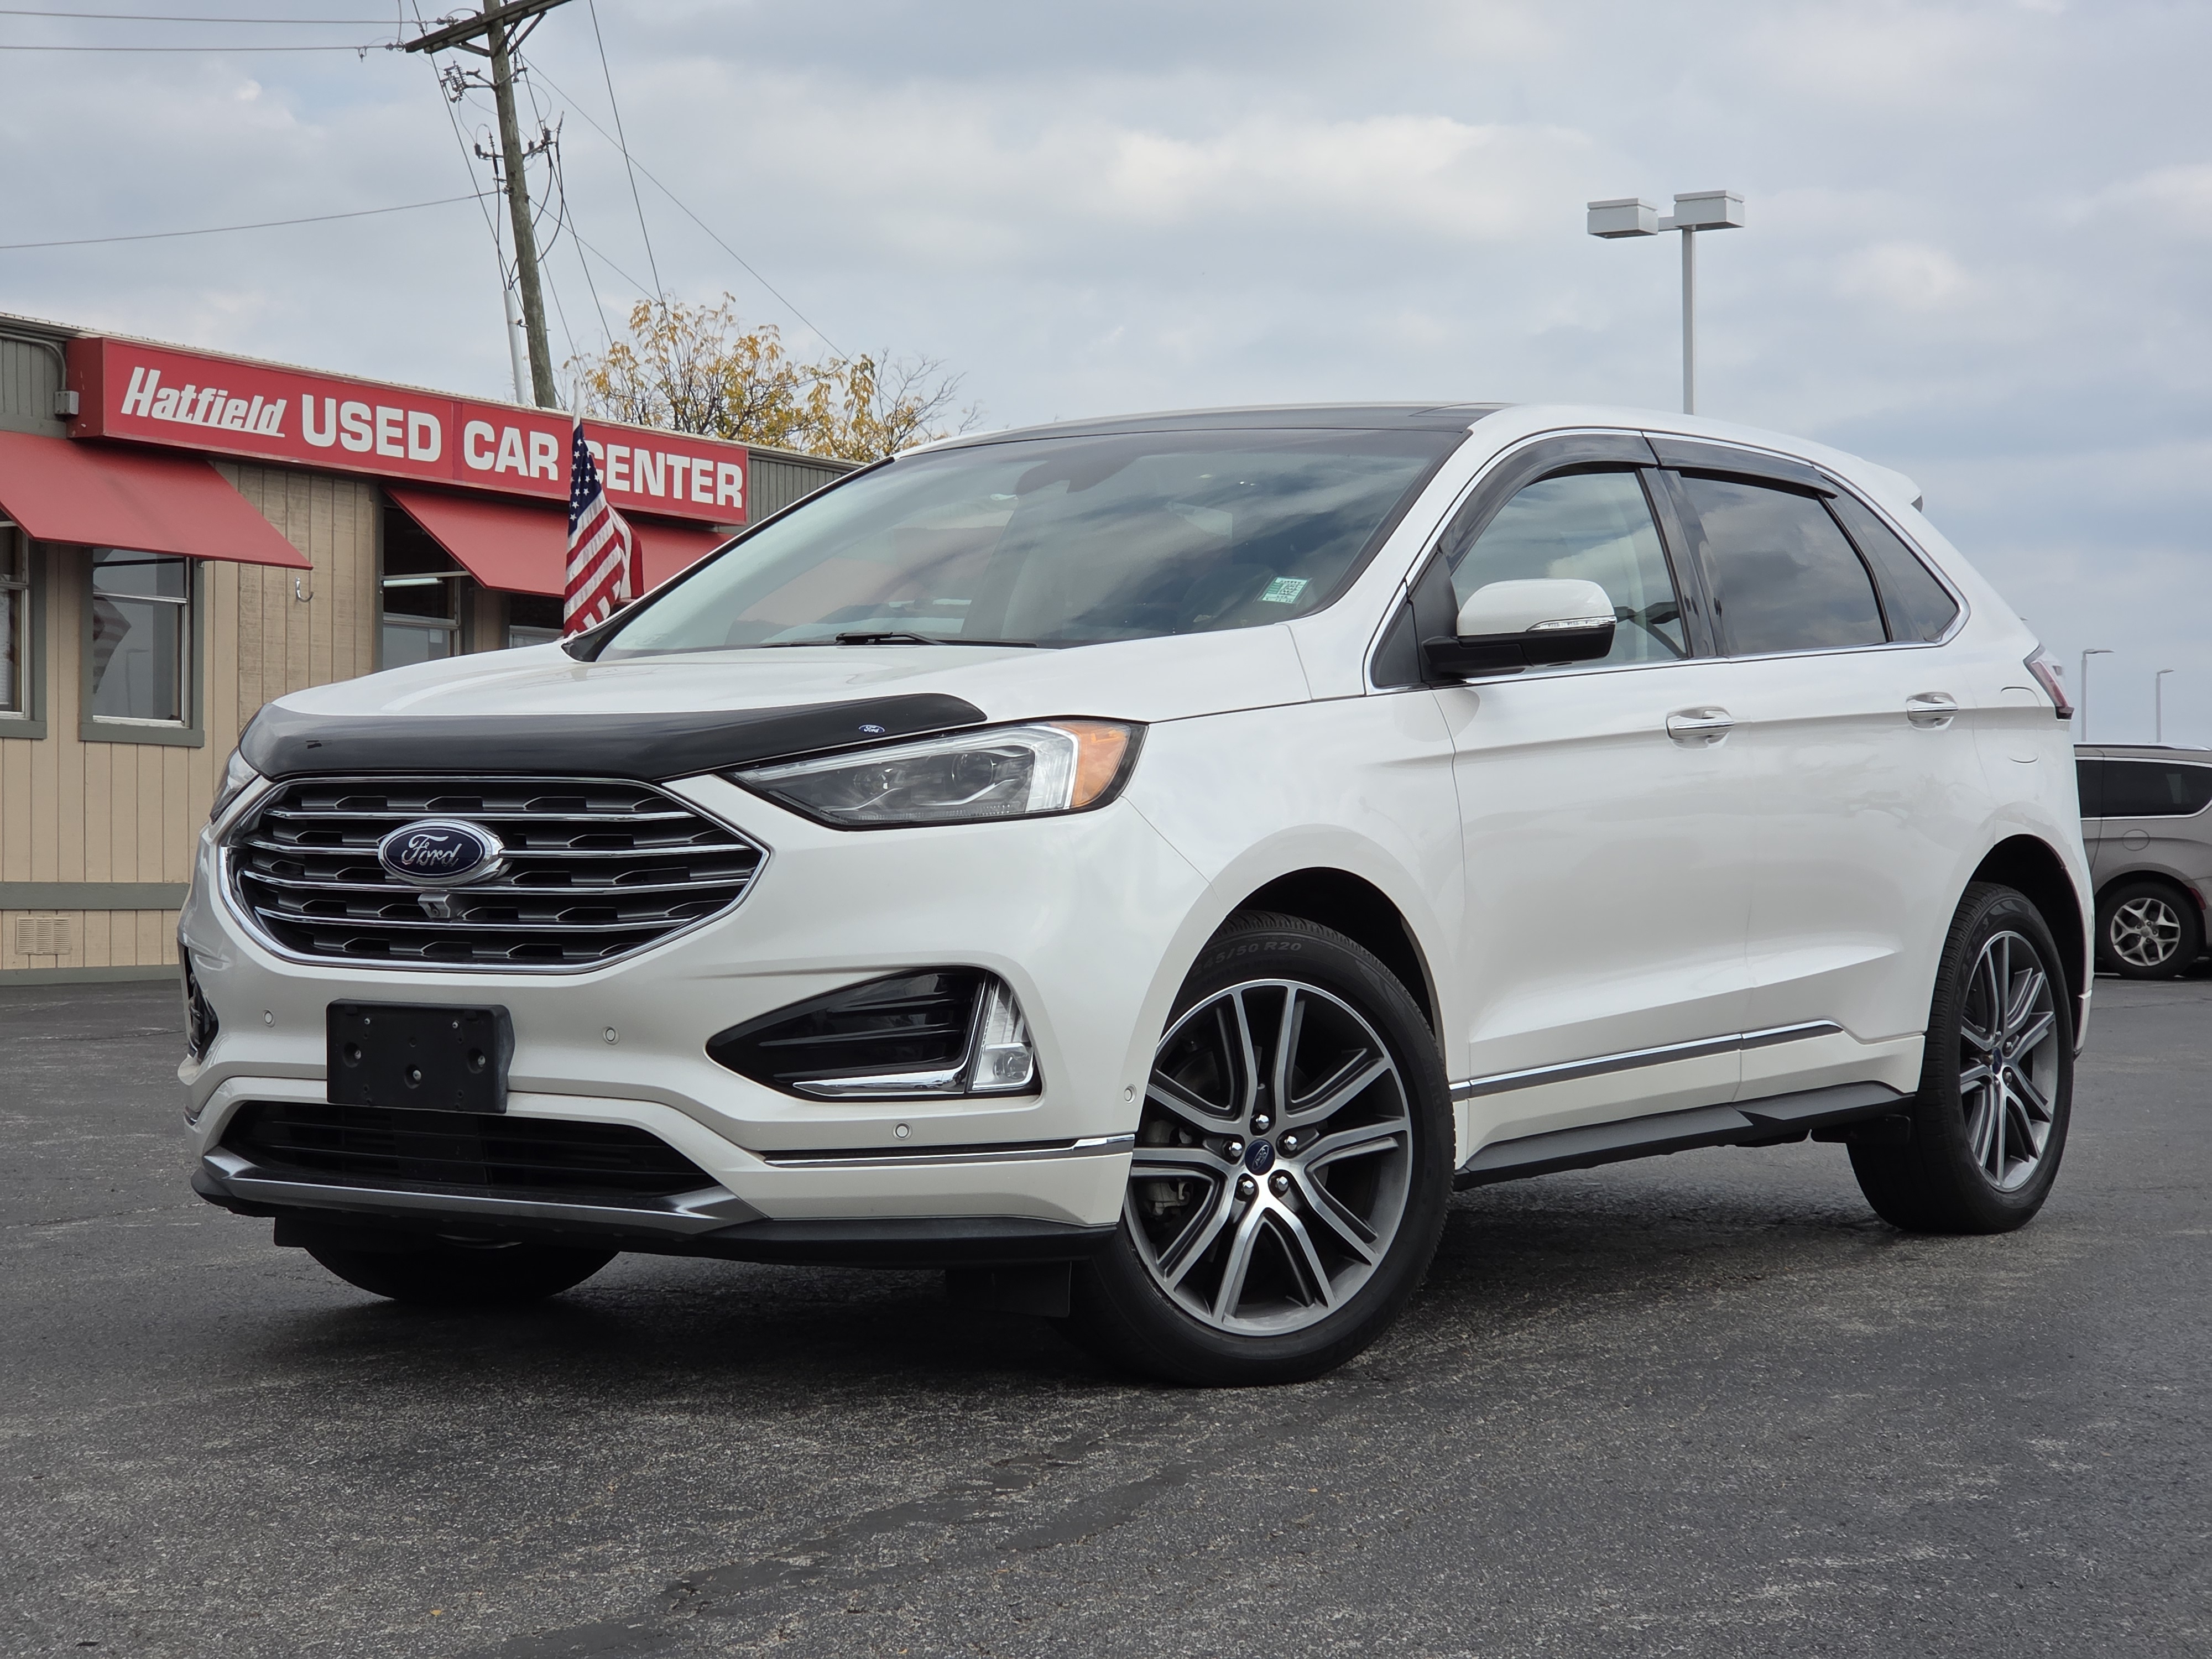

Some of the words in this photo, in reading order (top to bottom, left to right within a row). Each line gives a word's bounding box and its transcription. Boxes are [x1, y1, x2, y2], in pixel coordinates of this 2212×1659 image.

[121, 367, 286, 437] Hatfield
[302, 394, 441, 462] USED
[463, 420, 558, 481] CAR
[401, 834, 462, 867] Ford
[1264, 941, 1302, 951] R20
